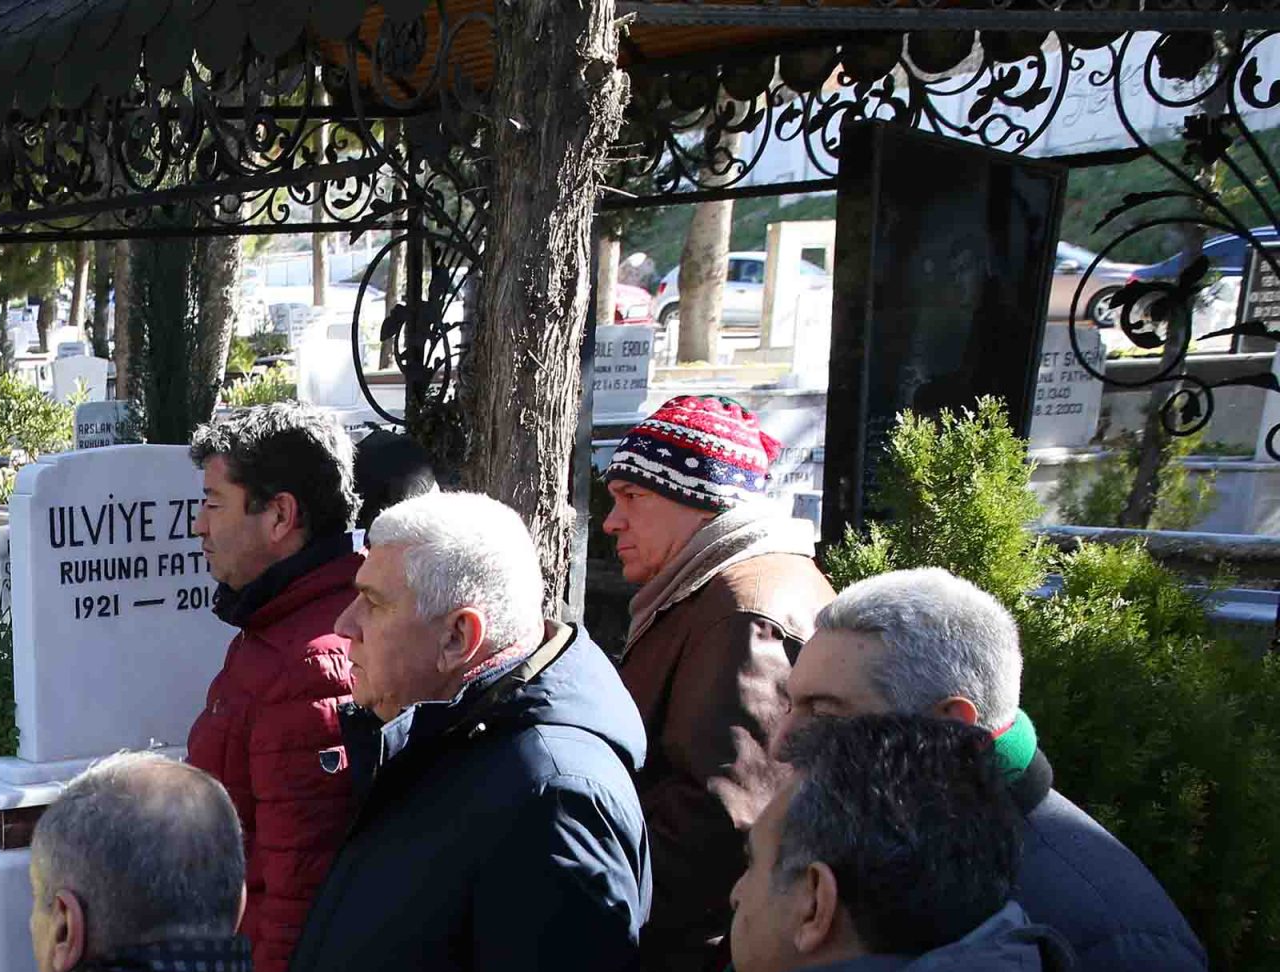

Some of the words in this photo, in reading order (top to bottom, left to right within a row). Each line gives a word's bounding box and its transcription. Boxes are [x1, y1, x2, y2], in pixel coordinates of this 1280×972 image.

[78, 422, 112, 435] ARSLAN
[48, 493, 157, 549] ULVİYE
[168, 498, 208, 540] ZE
[60, 556, 148, 585] RUHUNA
[74, 594, 120, 619] 1921
